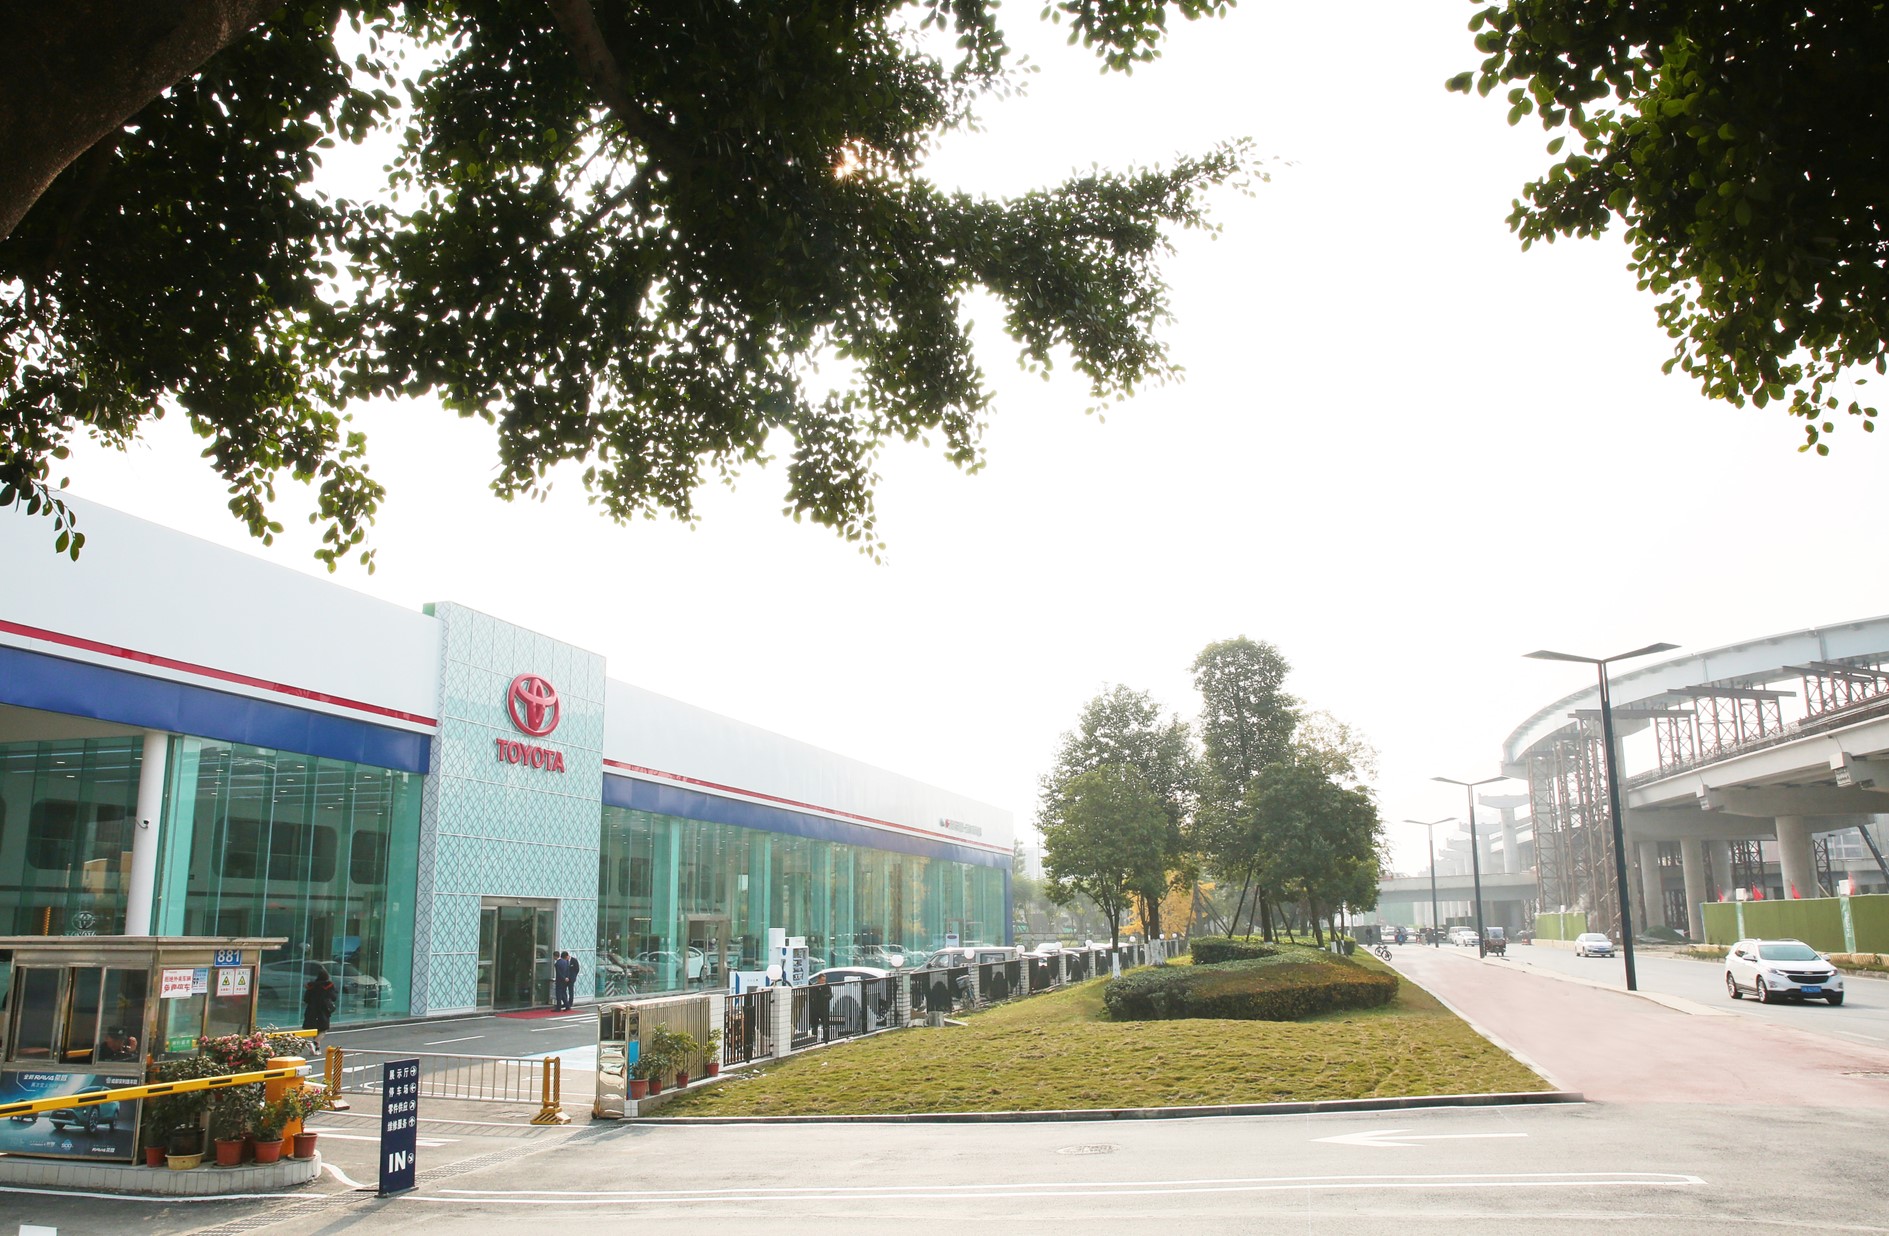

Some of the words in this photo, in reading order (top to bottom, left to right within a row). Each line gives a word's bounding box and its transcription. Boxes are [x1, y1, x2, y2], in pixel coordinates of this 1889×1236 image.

[496, 738, 564, 772] TOYOTA
[217, 949, 239, 962] 881
[389, 1068, 409, 1080] 展示厅
[389, 1085, 408, 1097] 停车场
[388, 1150, 406, 1173] IN
